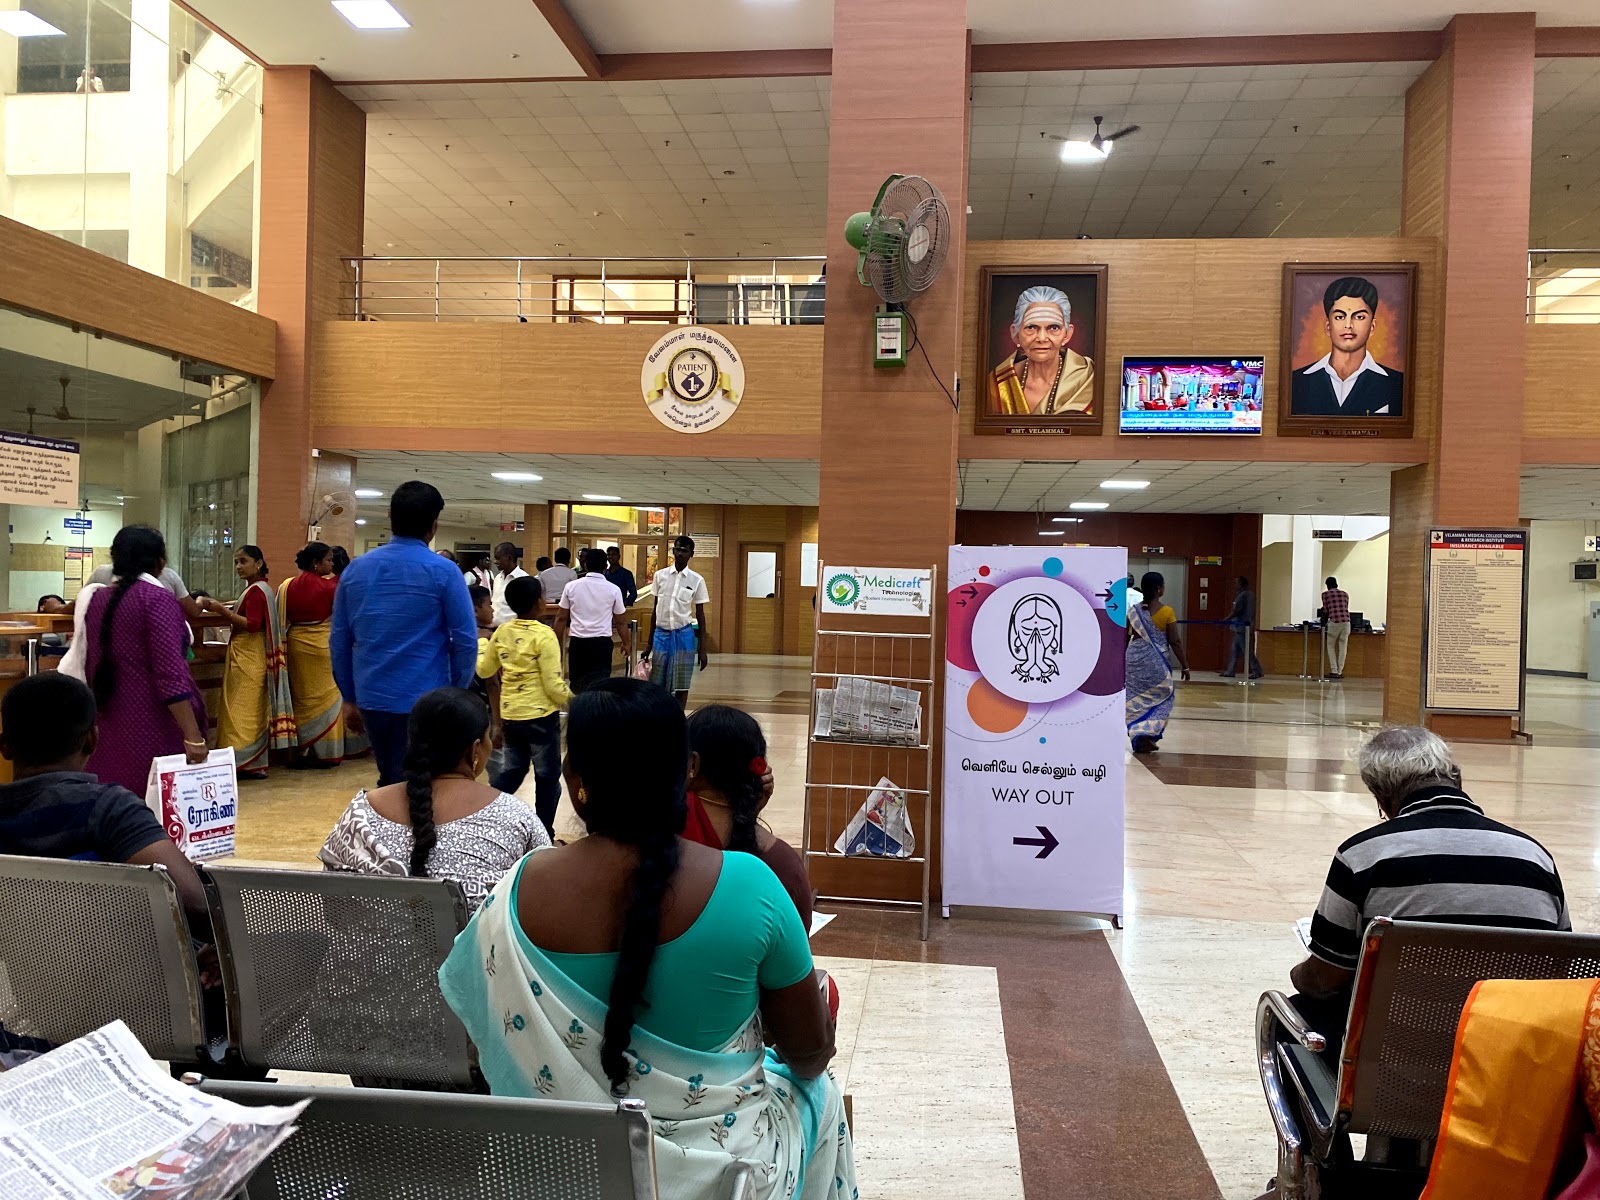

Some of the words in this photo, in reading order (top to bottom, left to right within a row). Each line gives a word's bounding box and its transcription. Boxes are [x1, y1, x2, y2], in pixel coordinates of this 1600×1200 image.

[690, 332, 737, 363] மருத்துவமனை
[864, 575, 921, 589] Medicraft
[962, 758, 1017, 773] வெளியே
[1022, 761, 1077, 780] செல்லும்
[1082, 764, 1106, 782] வழி
[205, 785, 214, 799] R
[992, 787, 1030, 803] WAY
[1035, 789, 1075, 806] OUT
[187, 797, 236, 830] ரோகிணி
